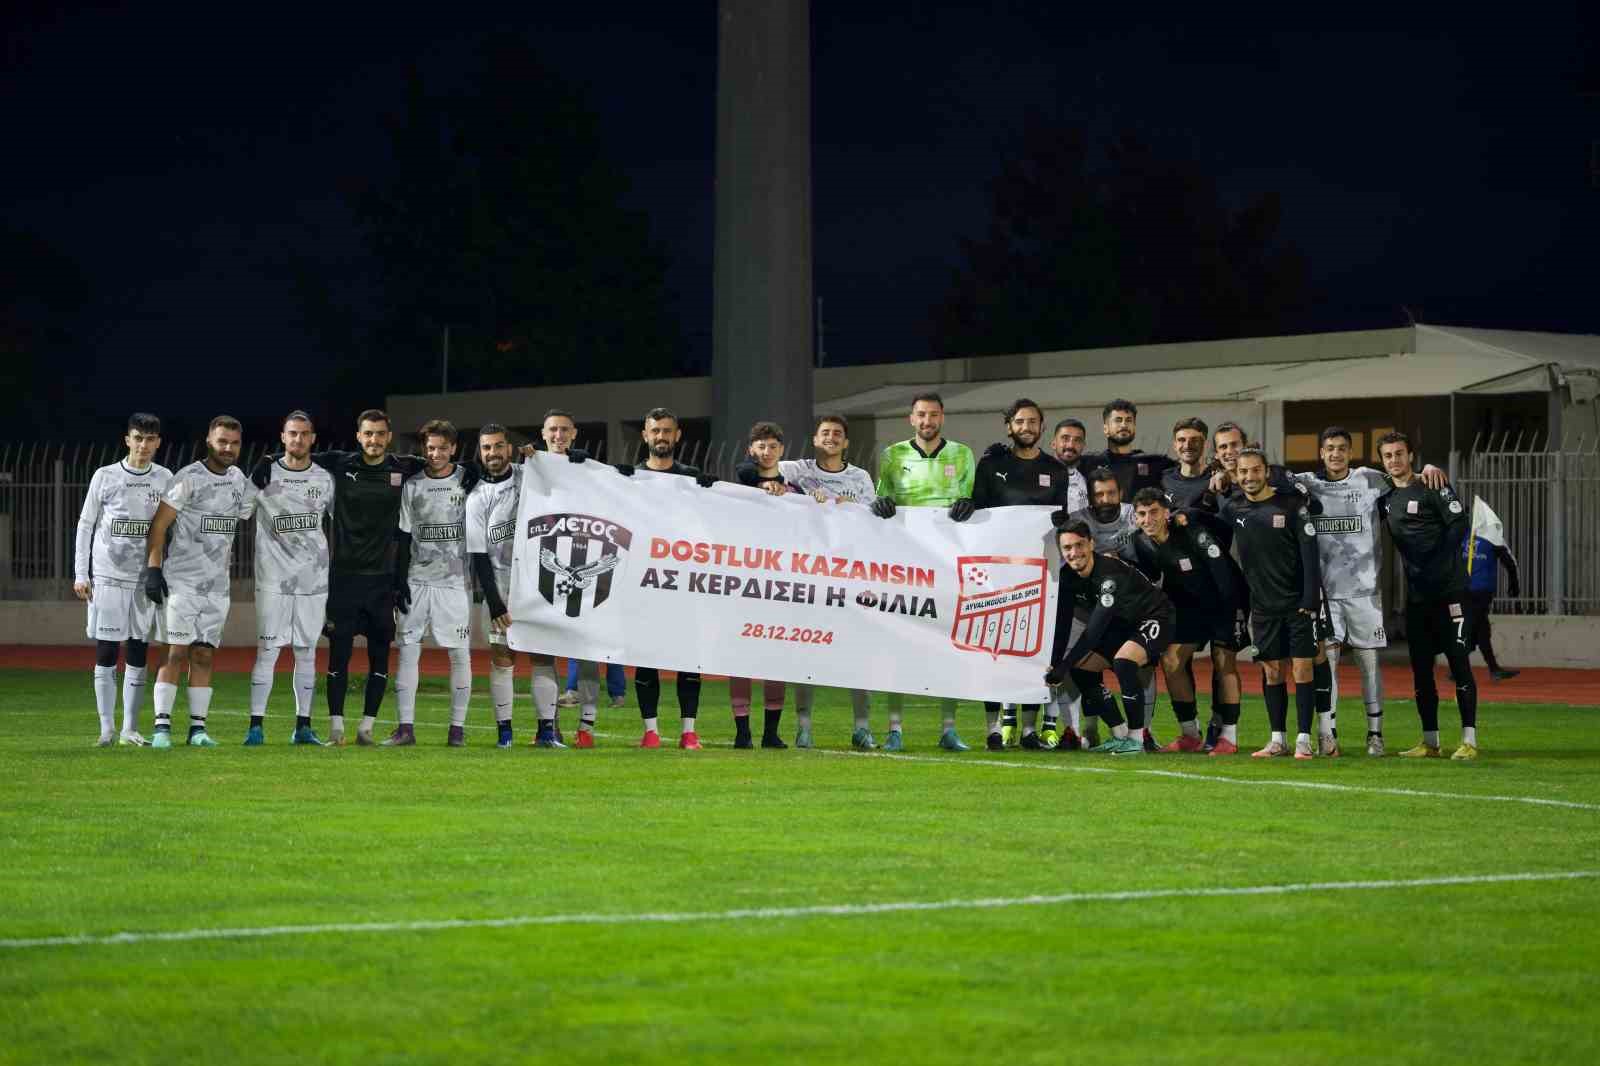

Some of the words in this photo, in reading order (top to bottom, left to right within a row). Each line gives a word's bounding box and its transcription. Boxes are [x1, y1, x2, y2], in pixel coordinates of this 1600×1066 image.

[650, 537, 784, 571] DOSTLUK
[791, 552, 935, 588] KAZANSIN
[640, 567, 679, 591] ΑΣ
[688, 572, 816, 604] ΚΕΡΔΙΣΕΙ
[826, 586, 846, 607] Η
[855, 590, 938, 619] ΦΙΛΙΑ
[741, 623, 834, 645] 28.12.2024
[1452, 617, 1465, 637] 7
